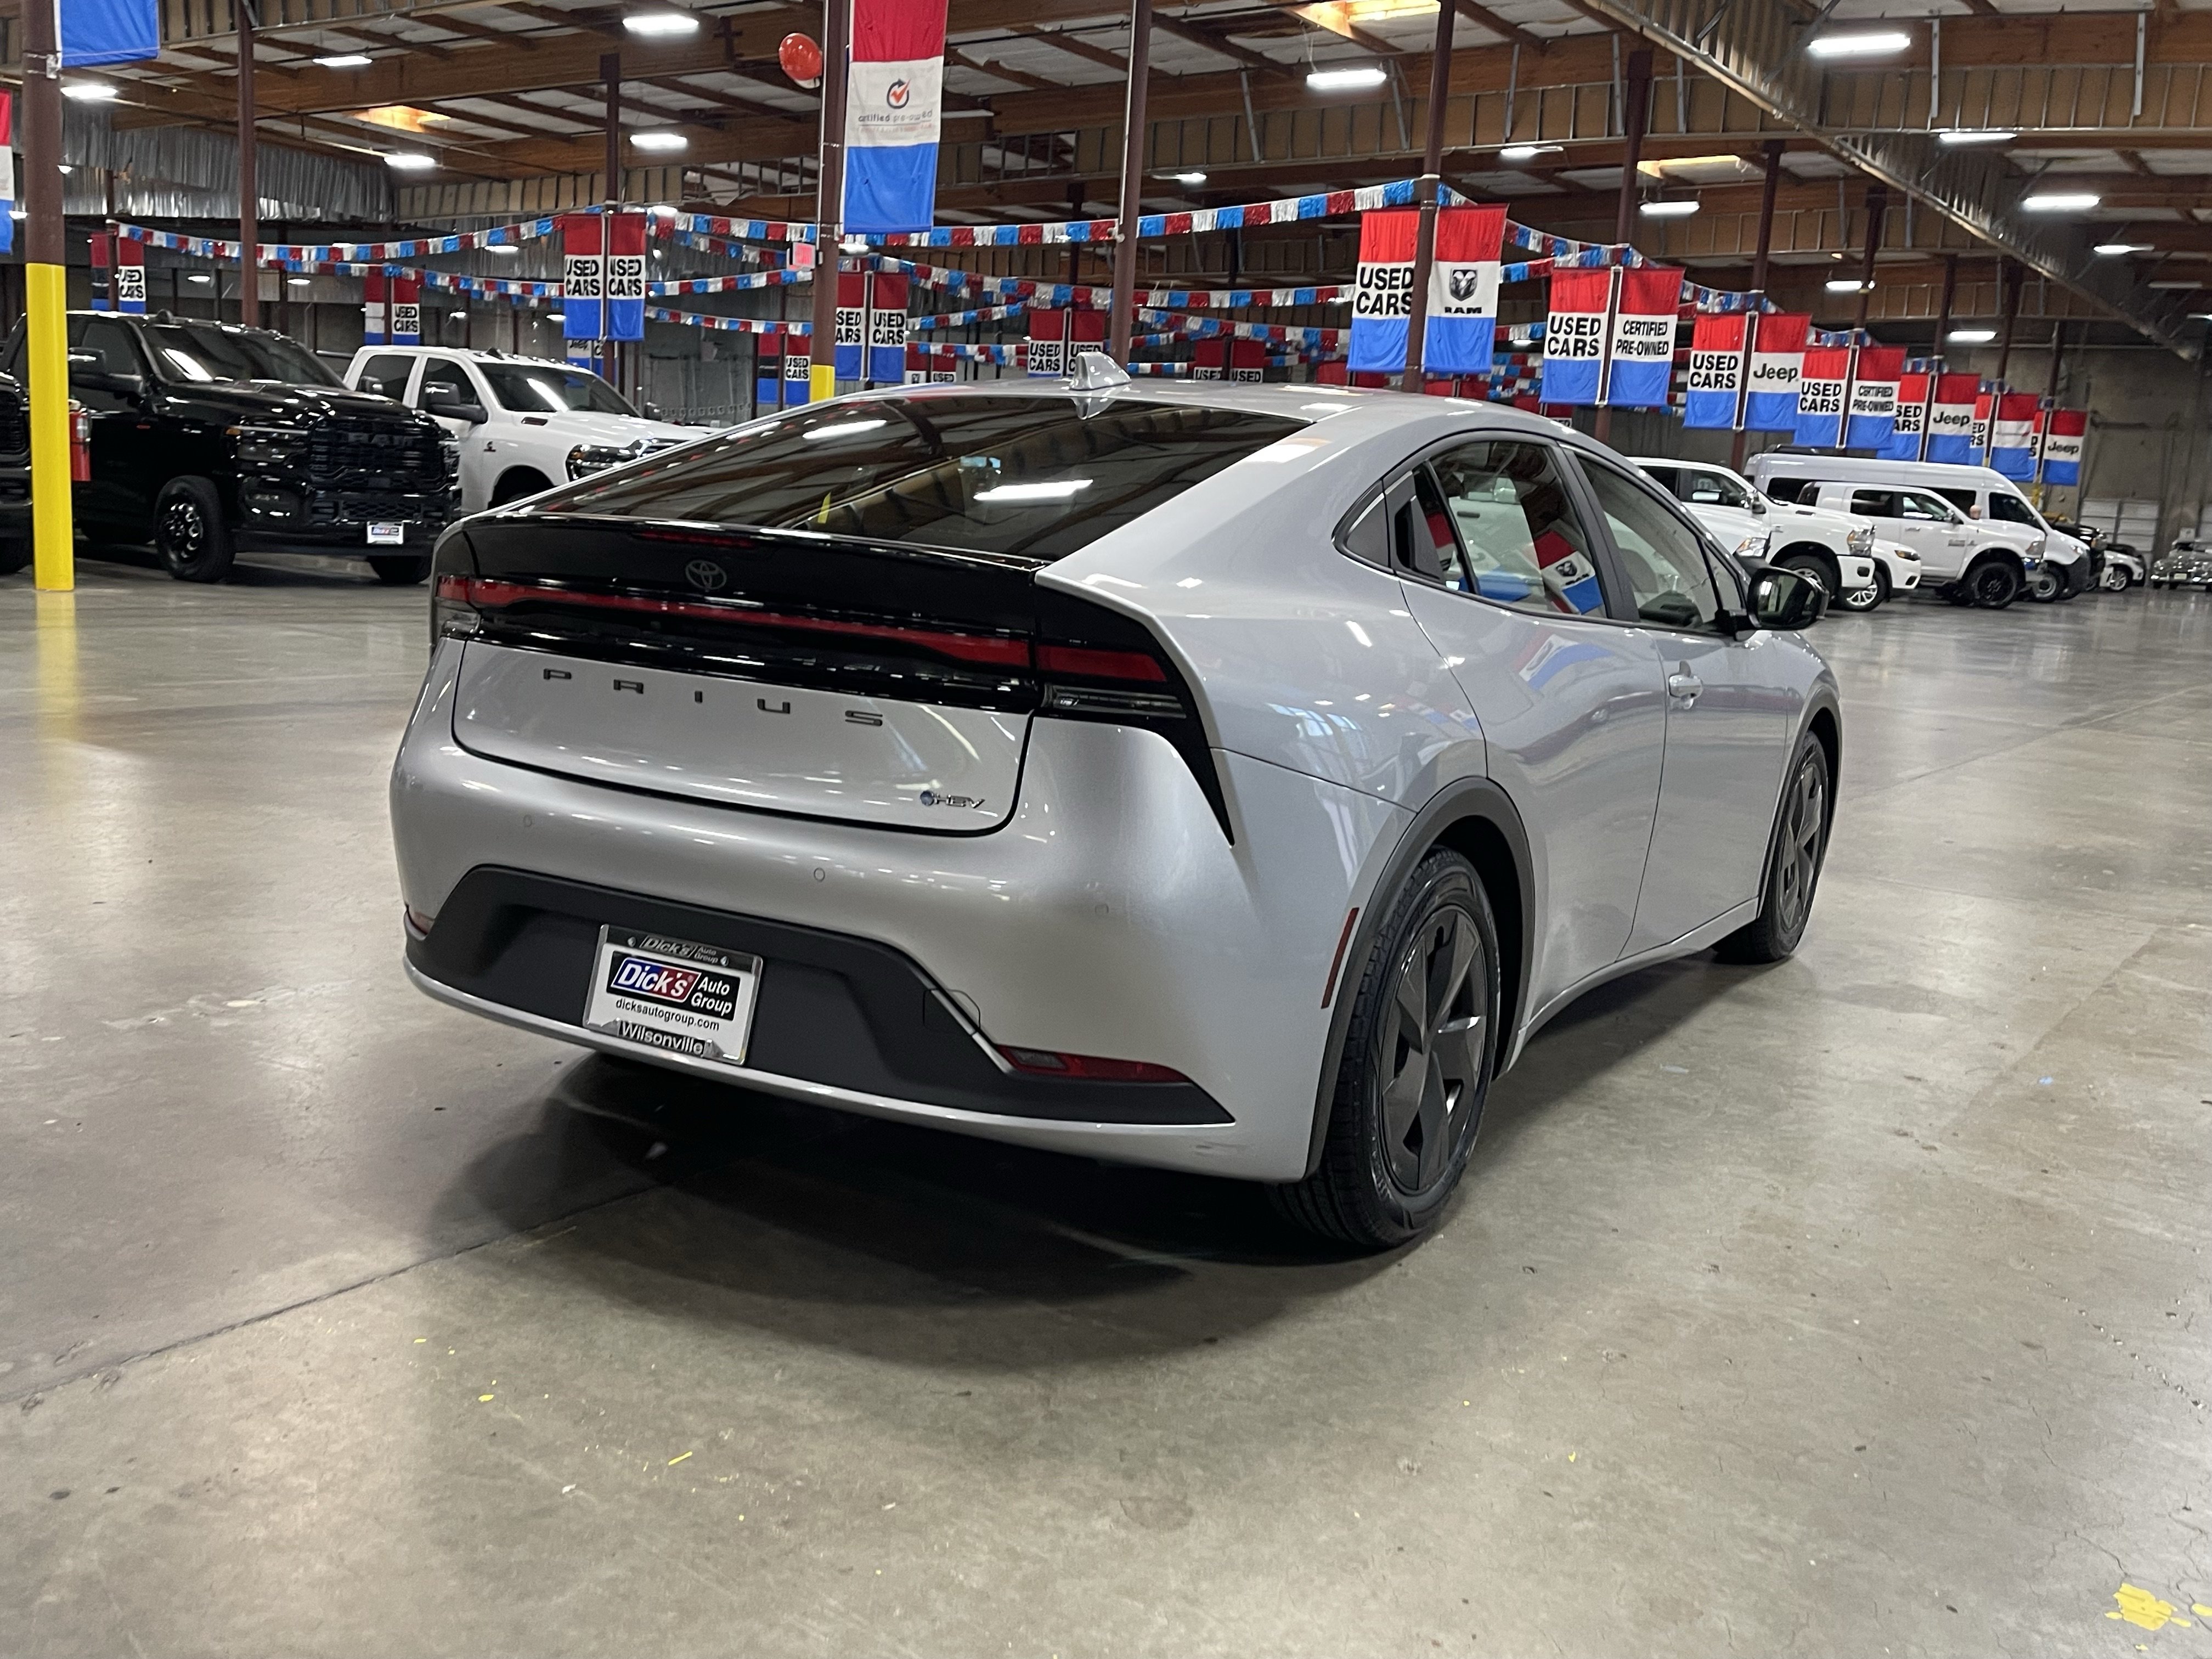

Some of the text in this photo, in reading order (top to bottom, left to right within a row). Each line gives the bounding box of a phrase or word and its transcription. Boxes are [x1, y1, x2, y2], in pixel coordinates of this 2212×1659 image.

[893, 110, 933, 122] pre-owed
[565, 258, 599, 276] USED
[610, 258, 641, 276] USED
[1359, 267, 1414, 290] USED
[566, 278, 601, 296] CARS
[608, 278, 642, 296] CARS
[1356, 291, 1412, 314] CARS
[836, 311, 861, 326] SED
[874, 312, 905, 328] USED
[1550, 316, 1601, 336] USED
[836, 328, 861, 343] ARS
[1623, 320, 1668, 336] CERTIFIED
[873, 329, 905, 345] CARS
[1030, 343, 1060, 357] USED
[1548, 336, 1599, 357] CARS
[1615, 339, 1669, 356] PRE-OWNED
[1030, 358, 1060, 371] CARS
[1693, 354, 1738, 371] USED
[933, 373, 954, 382] USED
[1196, 370, 1221, 380] USE
[1232, 370, 1261, 382] USED
[1690, 372, 1736, 388] CARS
[1753, 363, 1798, 383] Jeep
[1802, 382, 1842, 397] USED
[1799, 397, 1839, 412] CARS
[1896, 405, 1922, 417] SED
[1894, 420, 1920, 431] ARS
[1933, 411, 1970, 427] Jeep
[1972, 422, 1985, 434] ED
[2048, 442, 2079, 455] Jeep
[543, 668, 883, 726] PRIUS
[694, 952, 719, 964] Group
[697, 946, 716, 956] Auto
[617, 963, 687, 997] Dick's
[697, 977, 730, 996] Auto
[691, 991, 732, 1017] Group
[616, 997, 719, 1031] dicksautogroup.com
[620, 1021, 703, 1053] Wilsonville
